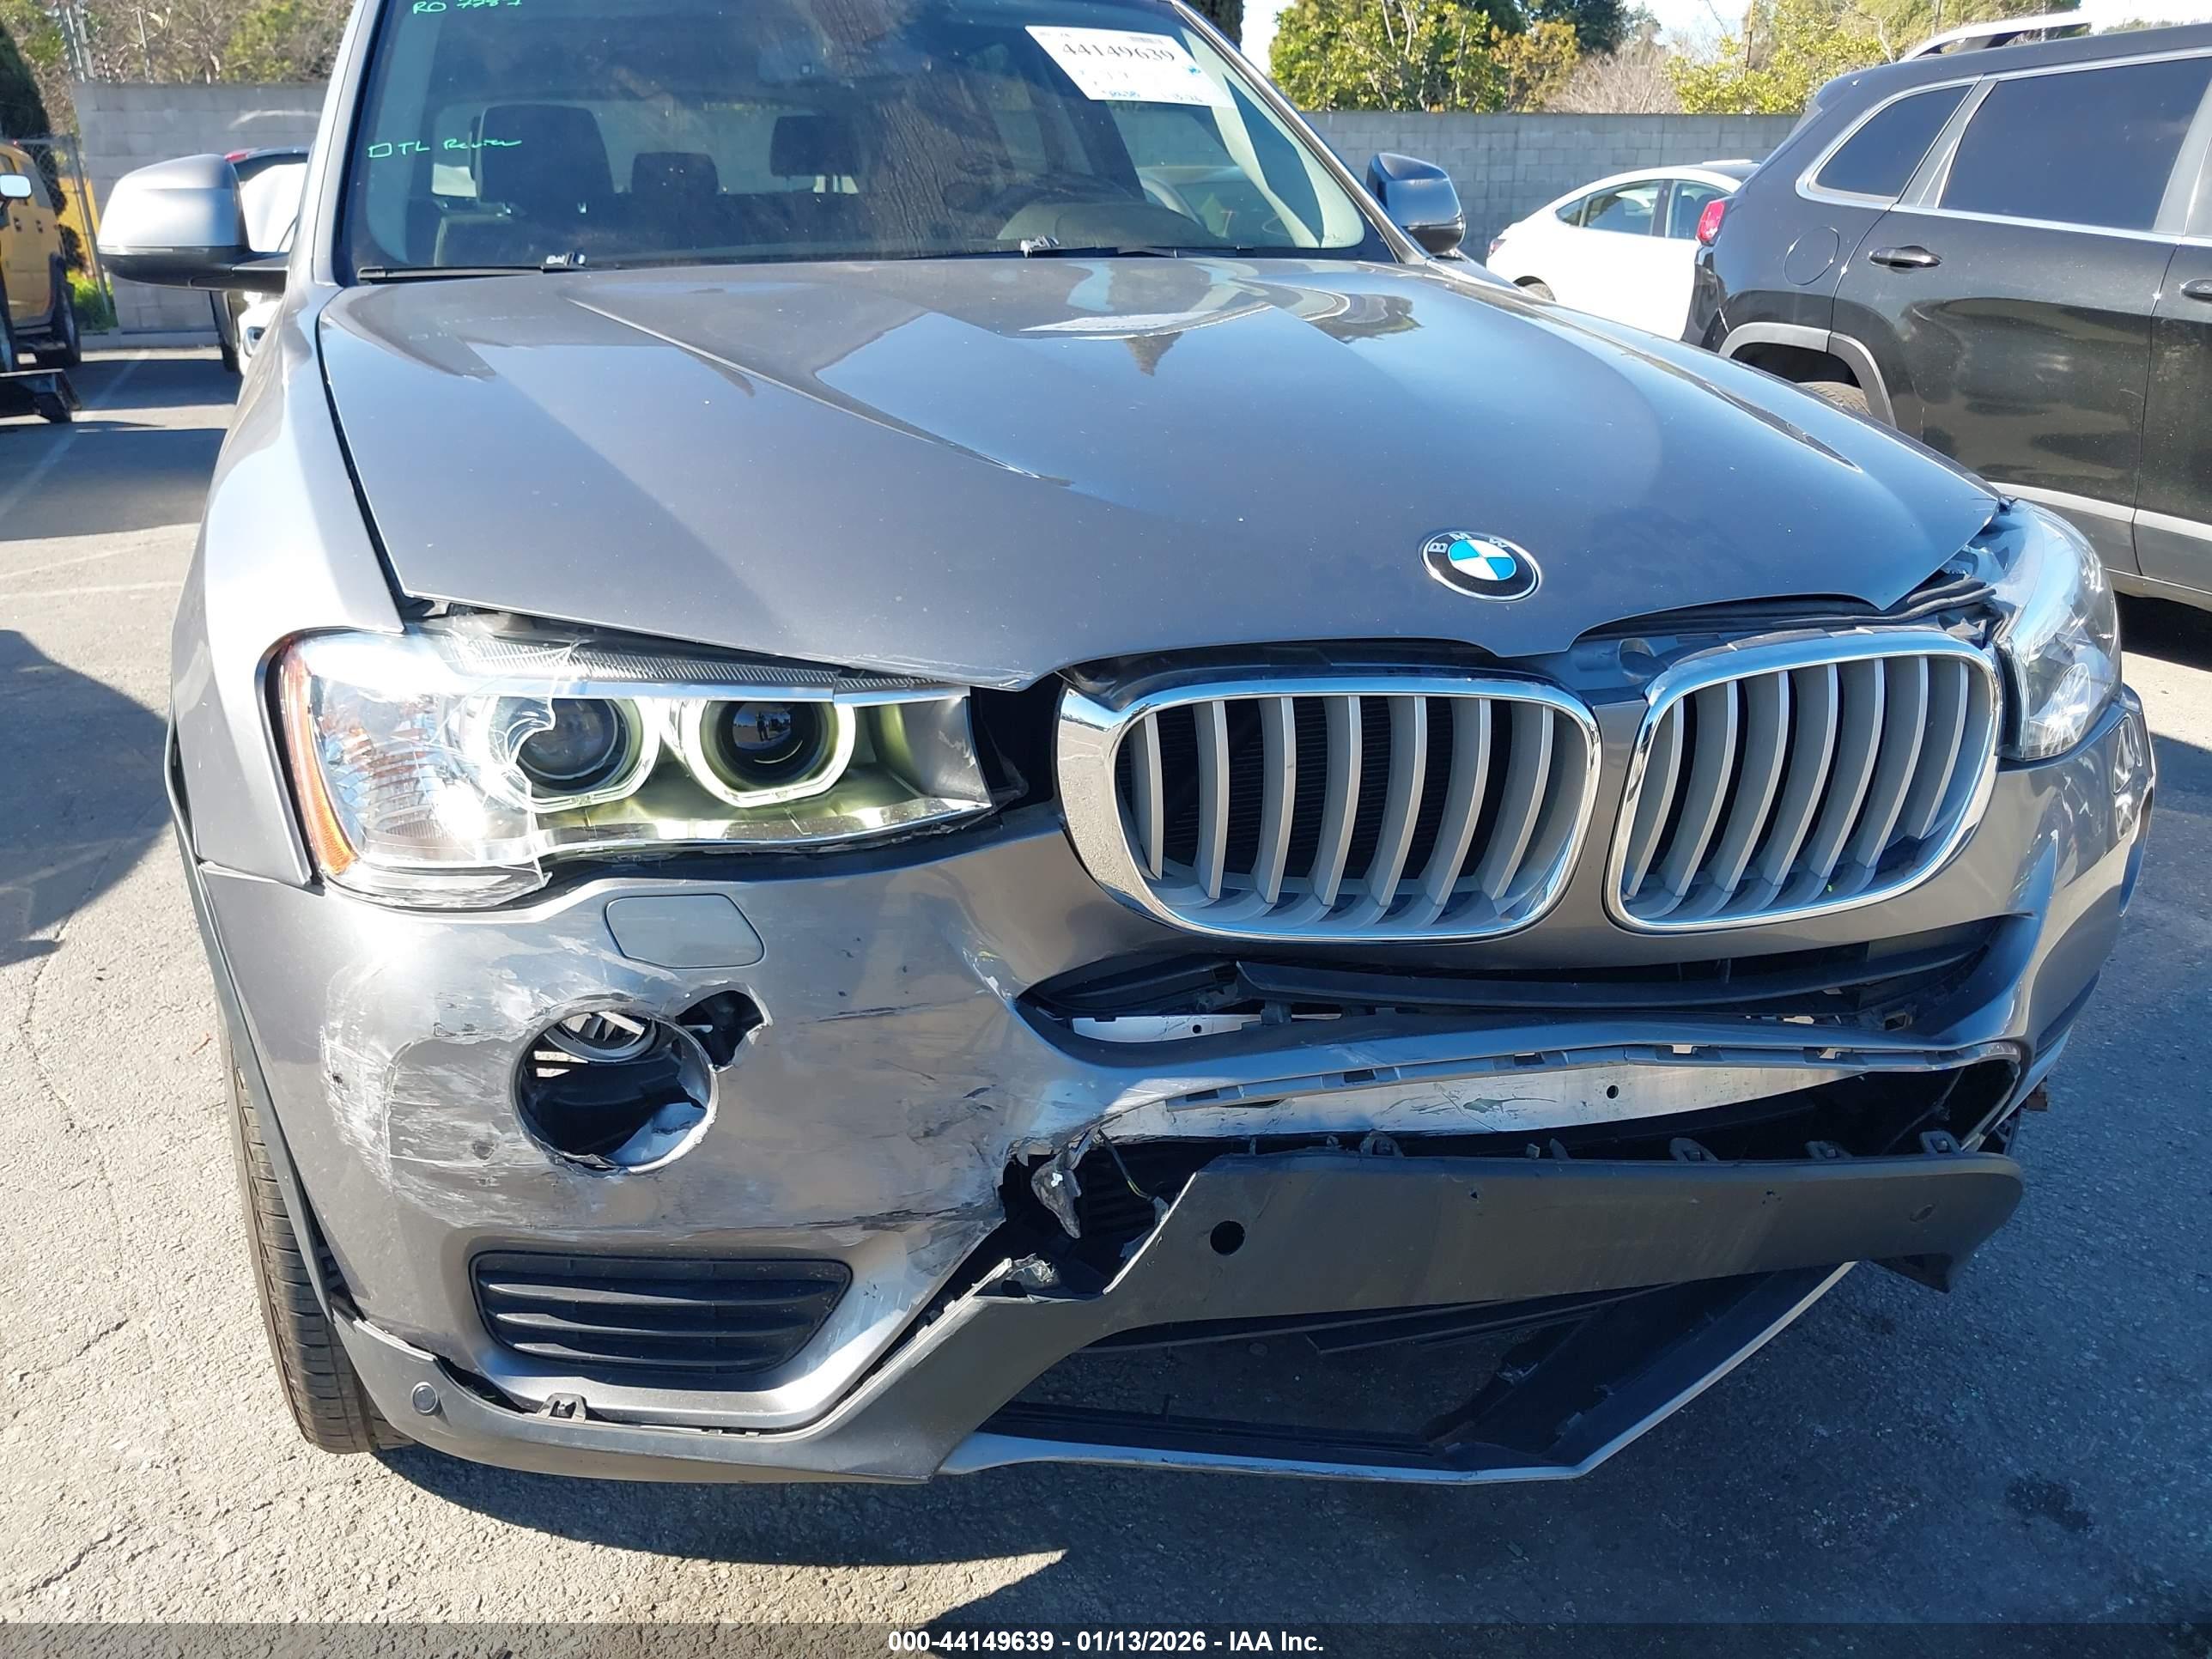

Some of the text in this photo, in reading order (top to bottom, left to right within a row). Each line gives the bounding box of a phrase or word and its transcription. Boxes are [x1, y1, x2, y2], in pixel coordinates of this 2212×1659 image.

[413, 1, 447, 14] RO
[1062, 43, 1176, 61] 44149639
[1428, 532, 1509, 555] BMW
